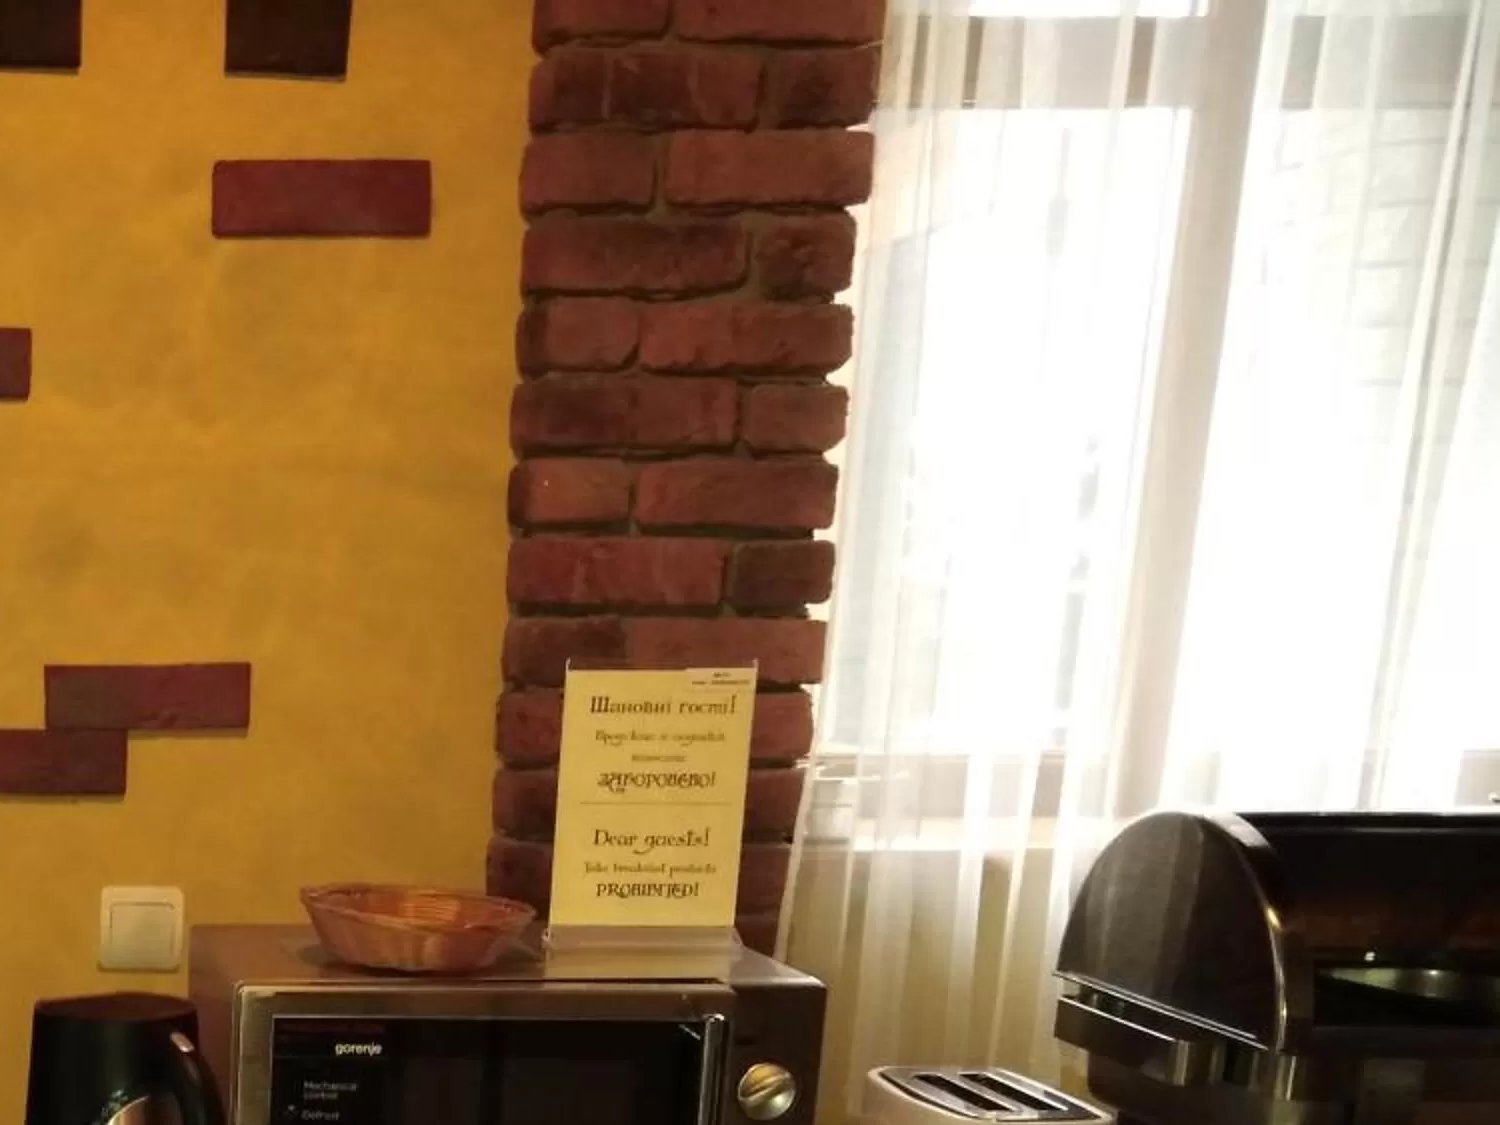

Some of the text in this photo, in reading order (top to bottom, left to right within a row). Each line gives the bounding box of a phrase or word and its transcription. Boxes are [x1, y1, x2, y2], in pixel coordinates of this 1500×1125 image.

[593, 827, 711, 855] Dear guests!
[335, 1042, 382, 1056] gorenje
